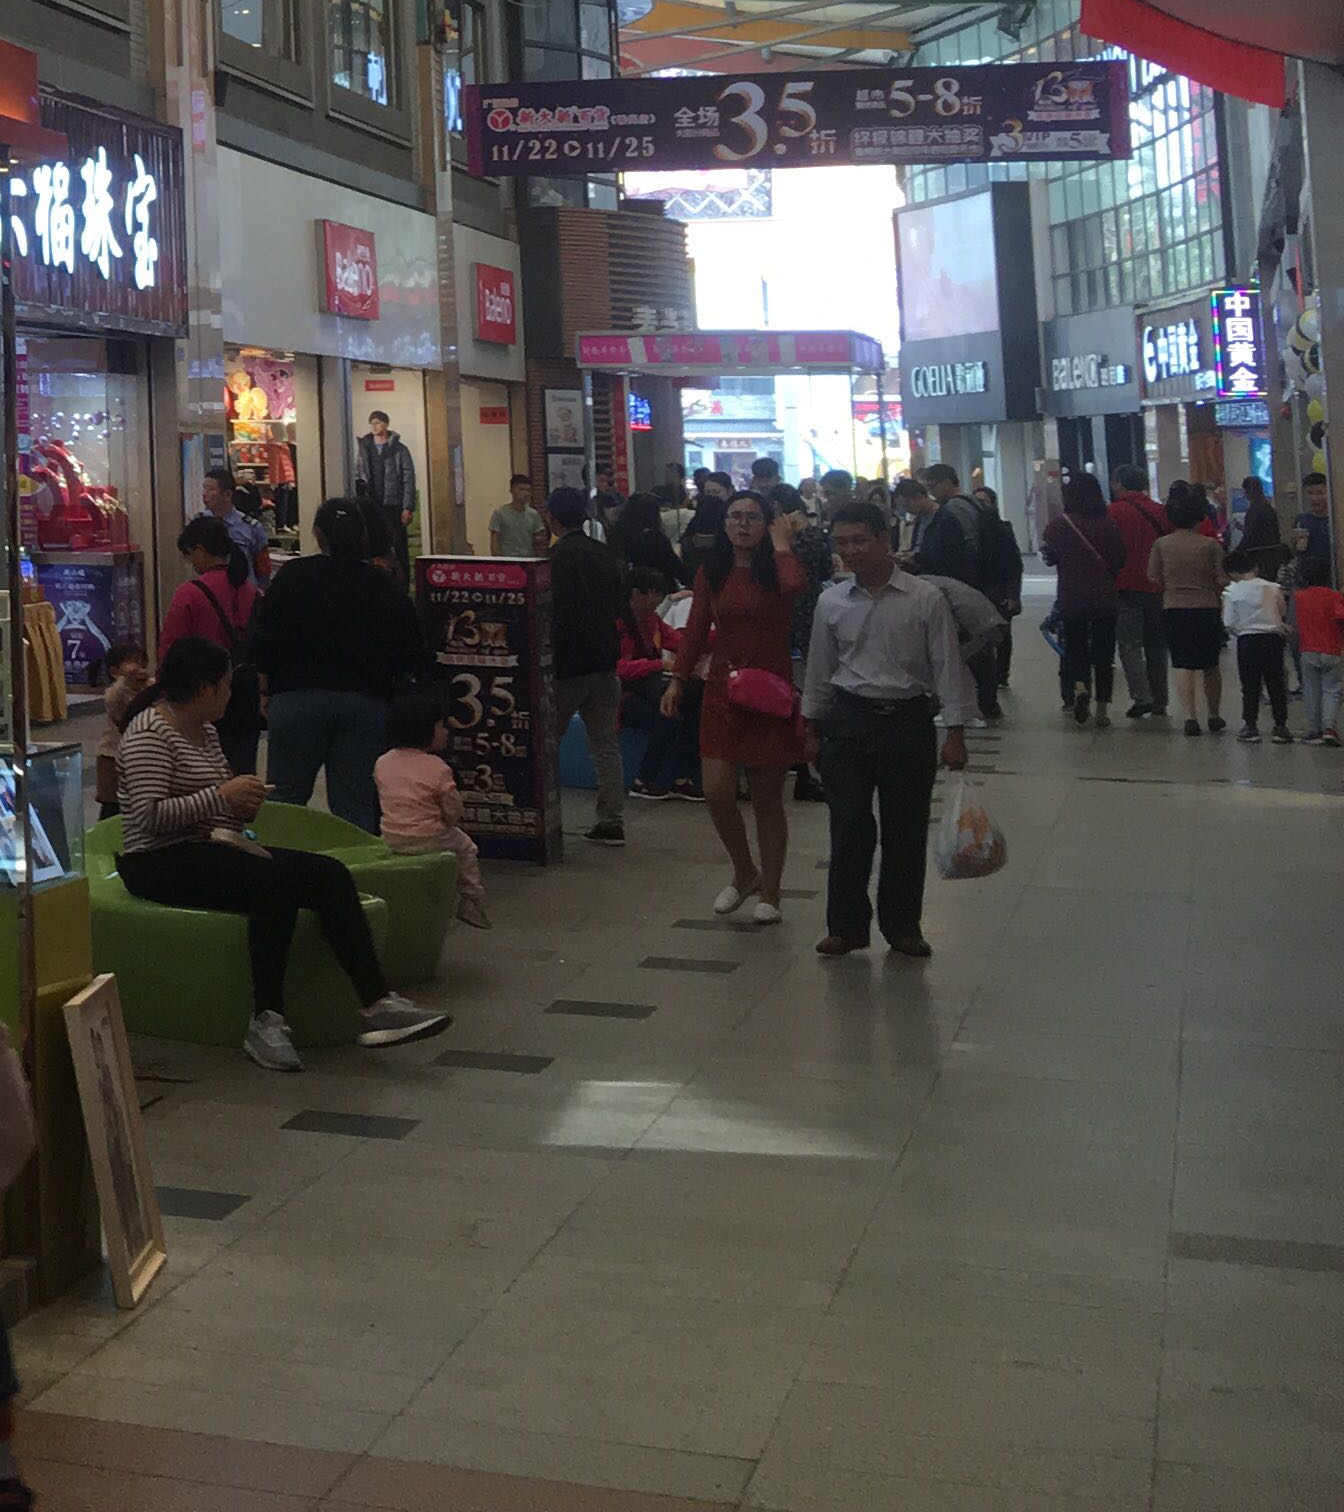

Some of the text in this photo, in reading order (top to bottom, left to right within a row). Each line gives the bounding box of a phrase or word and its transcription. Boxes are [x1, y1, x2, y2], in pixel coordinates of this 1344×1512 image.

[888, 77, 962, 119] 5-8
[490, 136, 656, 162] 11/22 11/25
[1224, 290, 1259, 393] 中国黄金
